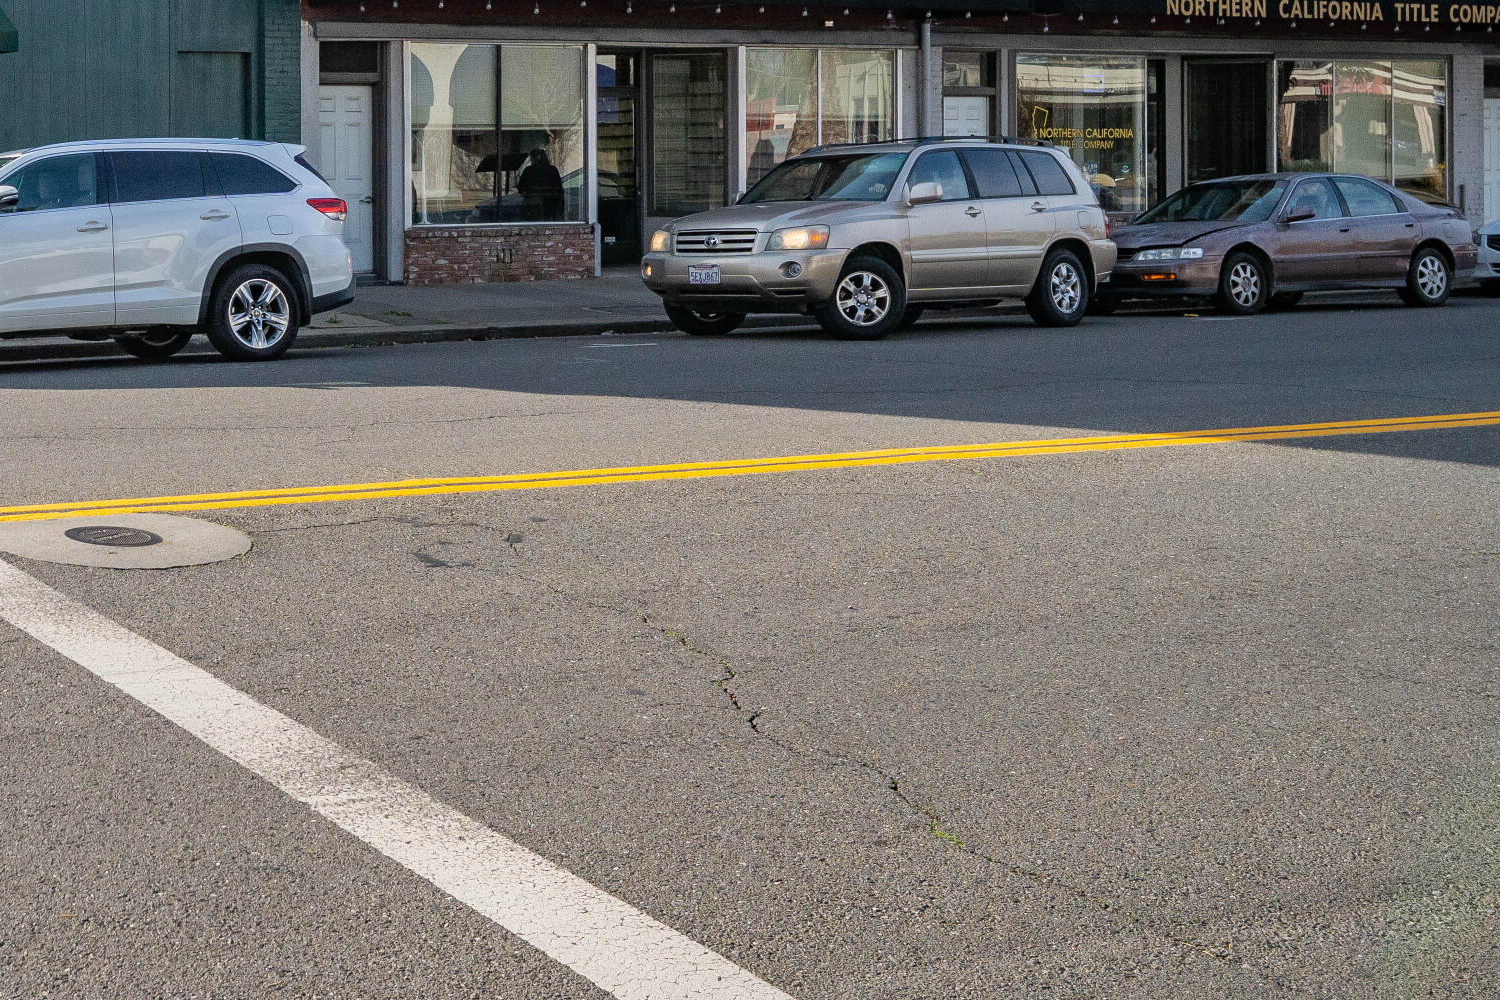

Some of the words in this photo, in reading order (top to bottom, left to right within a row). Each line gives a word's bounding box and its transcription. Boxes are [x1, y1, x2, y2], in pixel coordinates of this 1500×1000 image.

[1278, 0, 1383, 21] CALIFORNIA
[1394, 2, 1439, 23] TITLE
[1040, 127, 1083, 139] NORTHERN
[1085, 127, 1134, 139] CALIFORNIA
[1077, 140, 1114, 149] COMPANY
